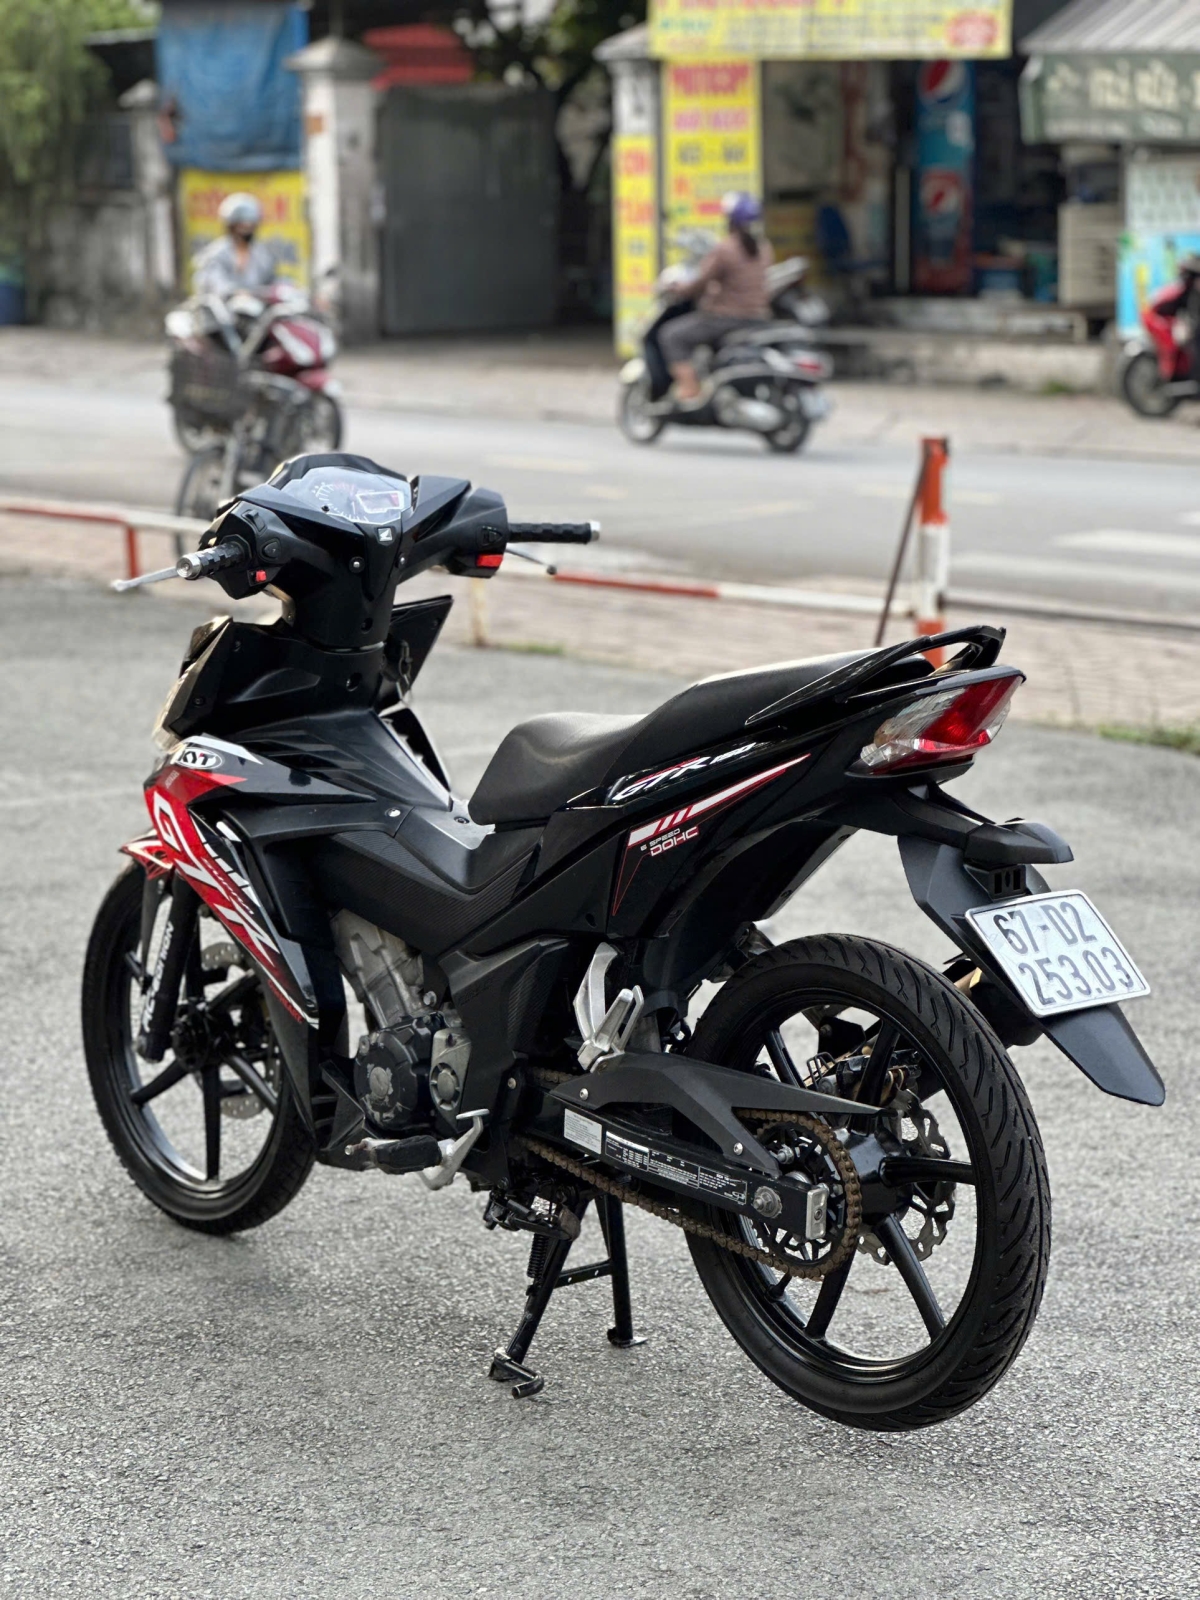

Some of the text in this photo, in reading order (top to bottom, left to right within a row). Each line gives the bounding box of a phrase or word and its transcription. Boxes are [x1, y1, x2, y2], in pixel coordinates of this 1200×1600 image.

[611, 756, 711, 801] GTR
[649, 828, 681, 847] SPEED
[650, 826, 699, 857] DOHC
[993, 901, 1097, 955] 67-D2
[1018, 947, 1135, 1006] 253.03
